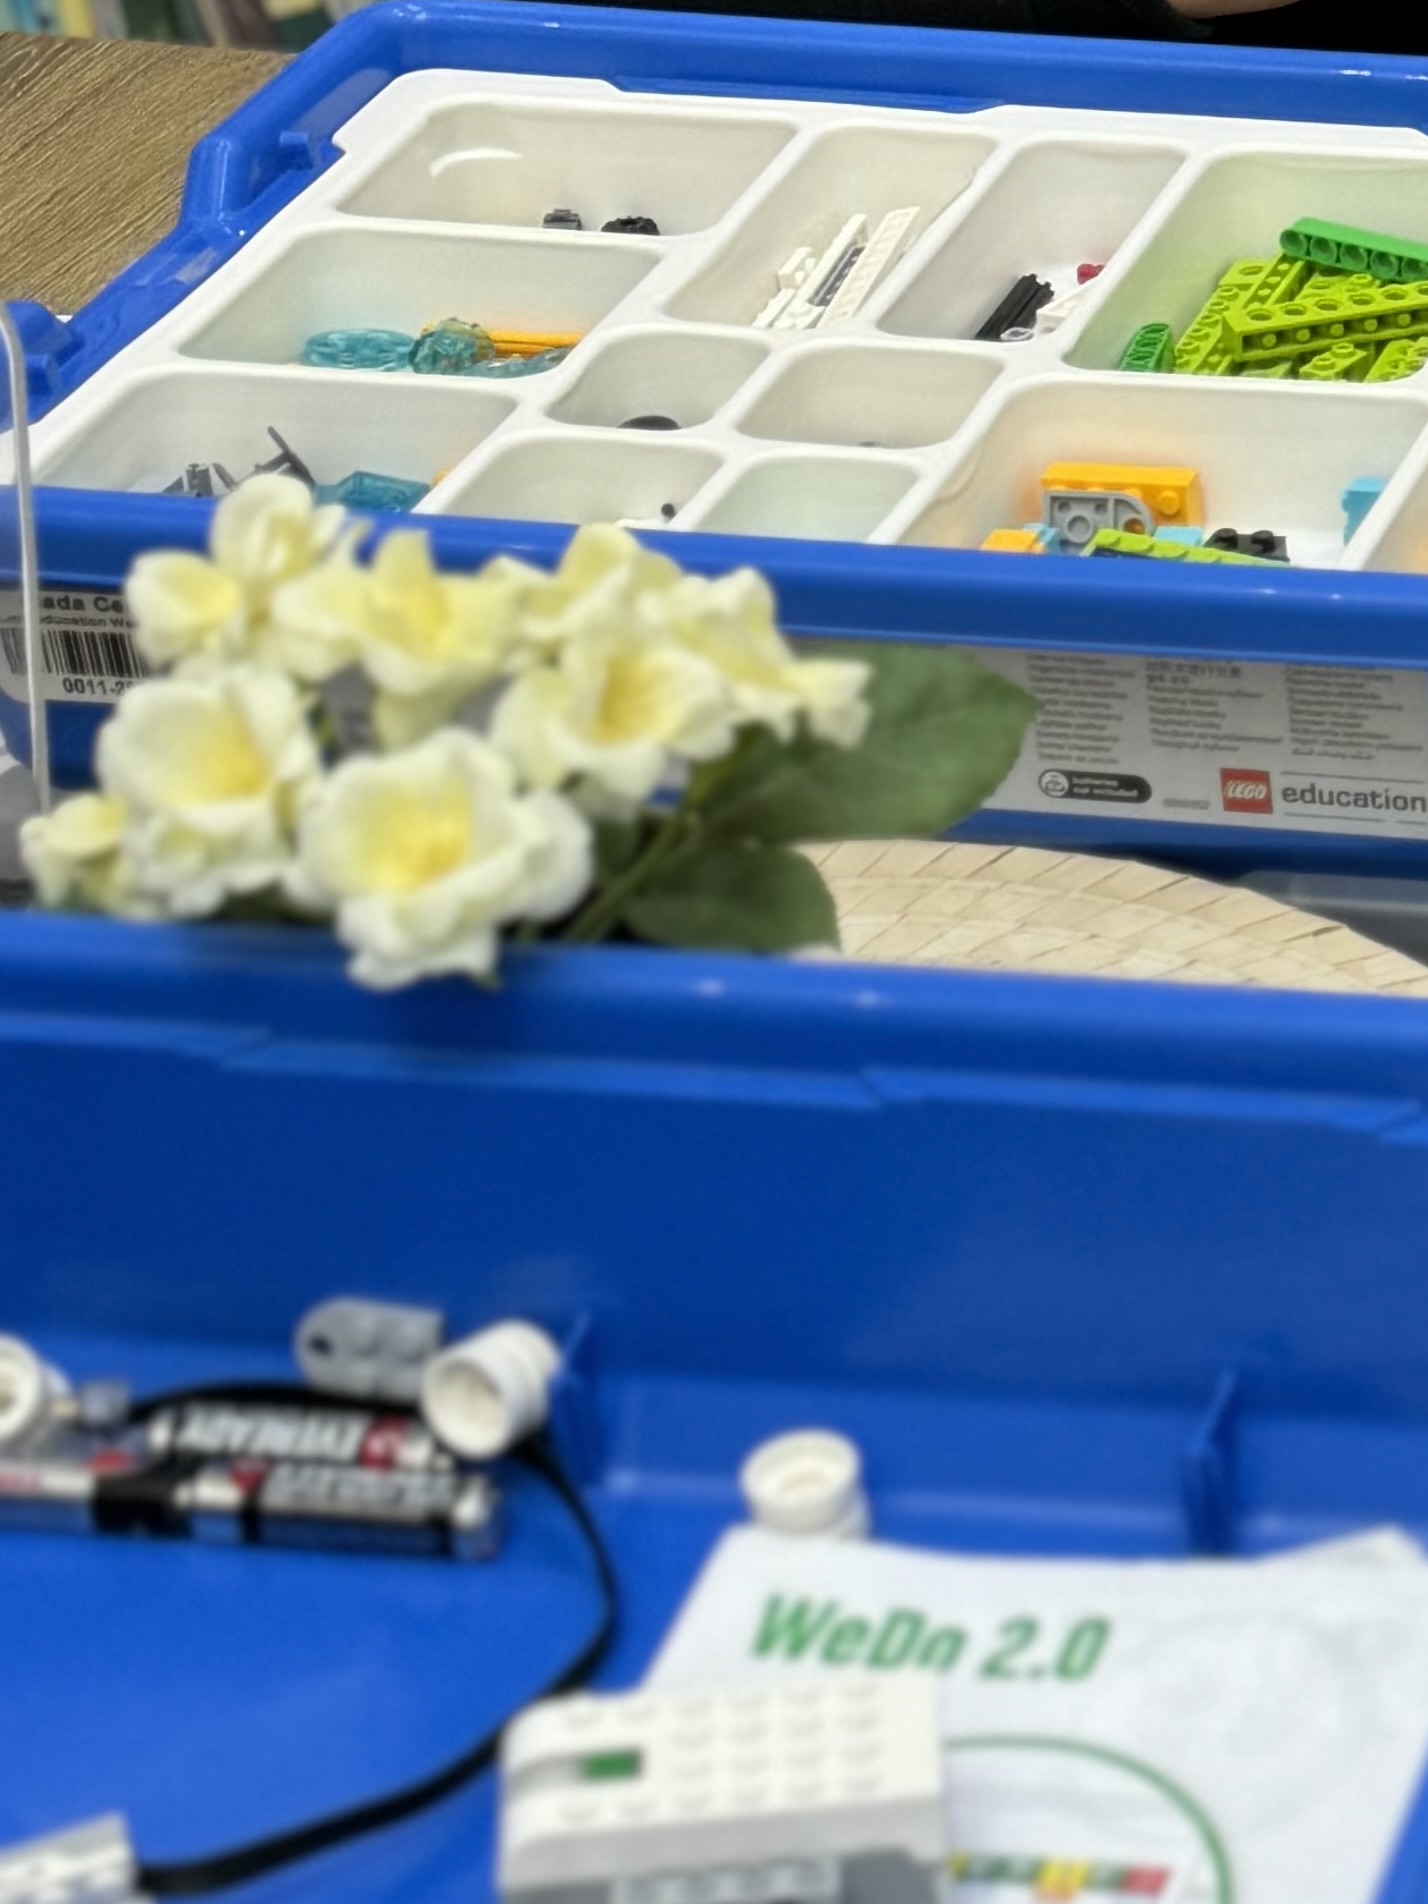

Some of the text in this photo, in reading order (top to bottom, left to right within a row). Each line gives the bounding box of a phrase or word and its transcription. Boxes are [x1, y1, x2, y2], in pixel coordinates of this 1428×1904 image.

[38, 595, 128, 614] ada Ce
[62, 677, 134, 696] 0011-2
[1224, 782, 1428, 813] LEGO education
[976, 1613, 1113, 1684] 2.0
